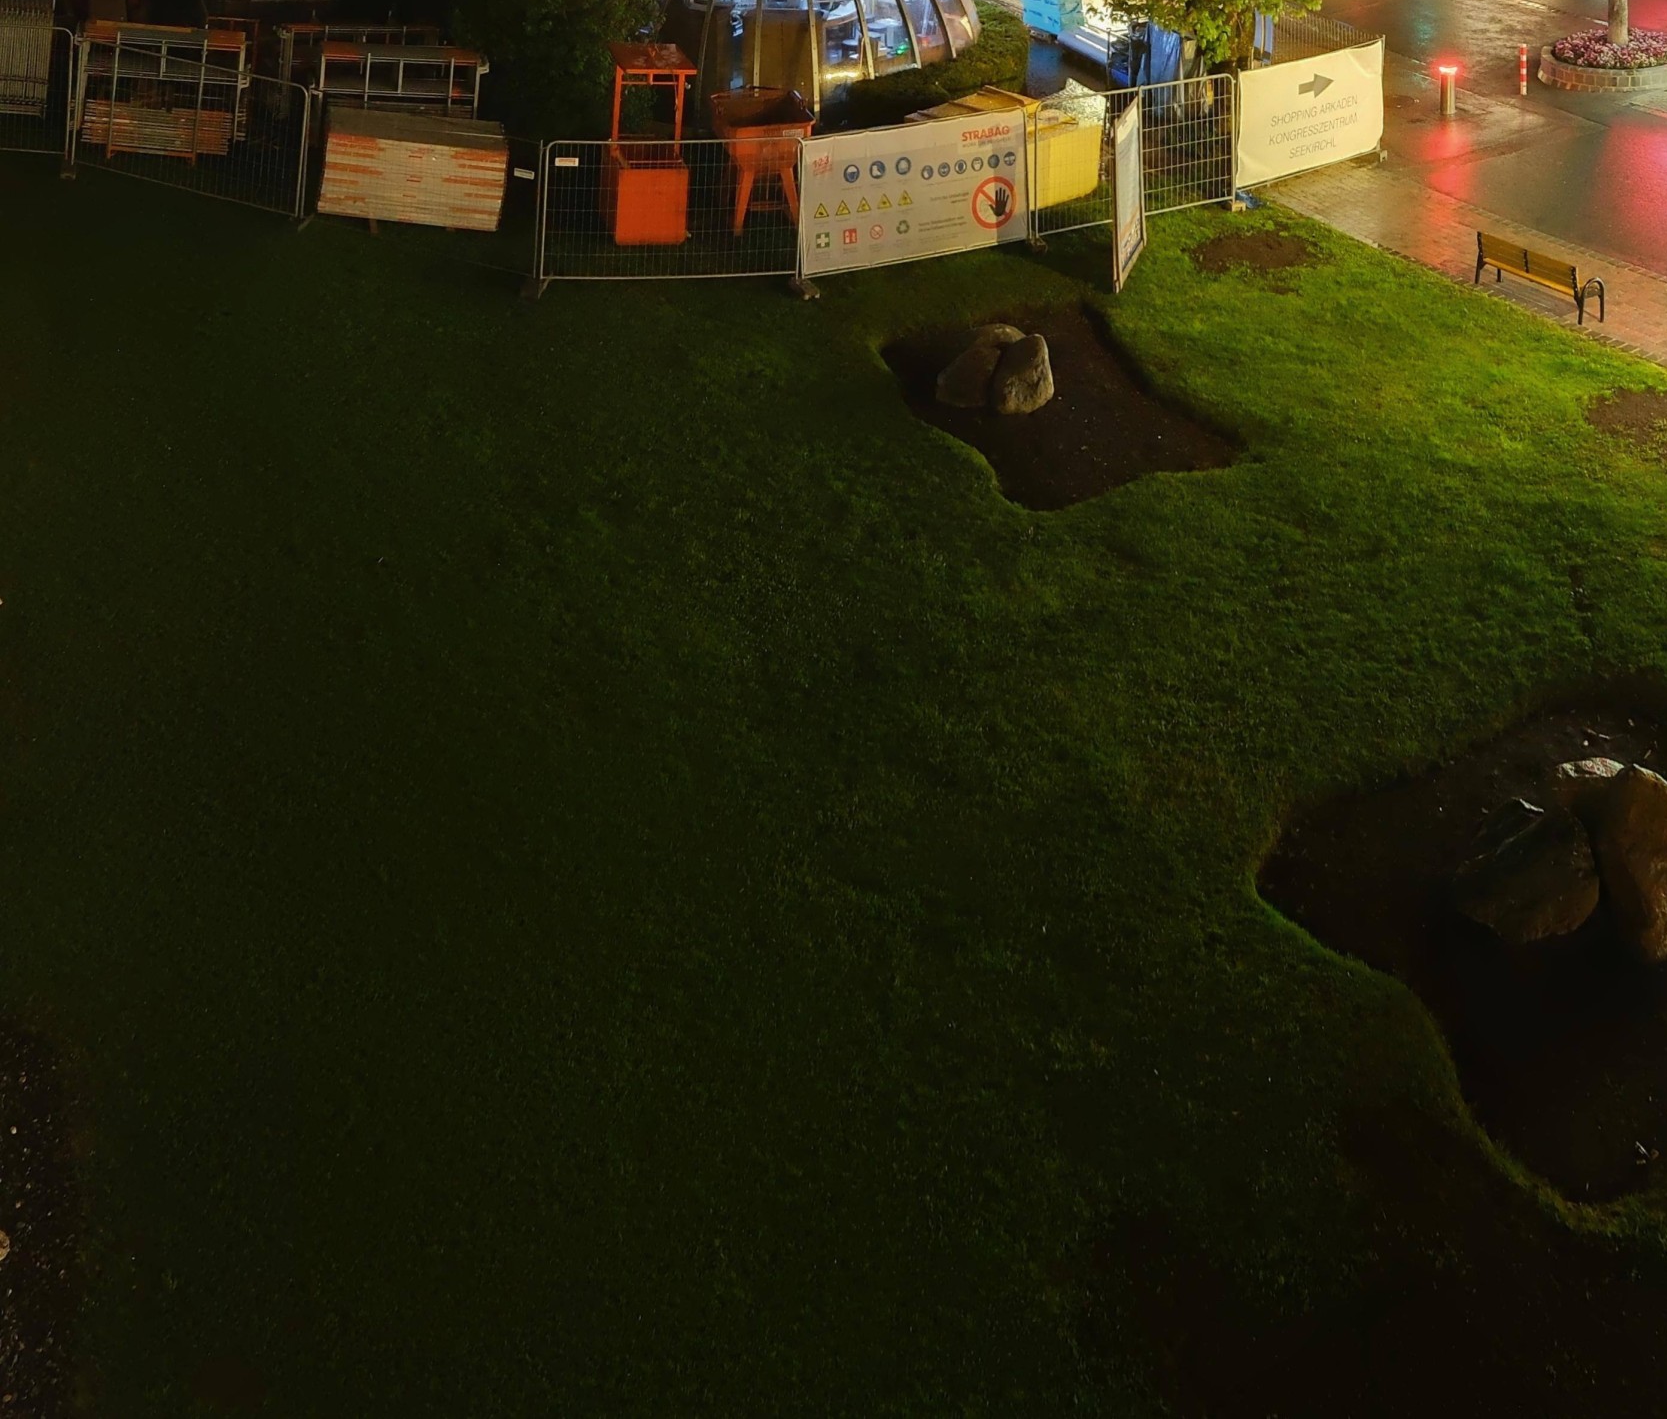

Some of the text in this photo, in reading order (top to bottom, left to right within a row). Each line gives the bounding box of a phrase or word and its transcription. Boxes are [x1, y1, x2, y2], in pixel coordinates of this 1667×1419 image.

[1270, 94, 1358, 128] SHOPPING ARKADEN
[961, 125, 1011, 142] STRABAG
[1268, 112, 1358, 146] KONGRESSZENTRUM
[1288, 137, 1337, 159] SEEKIRCHL
